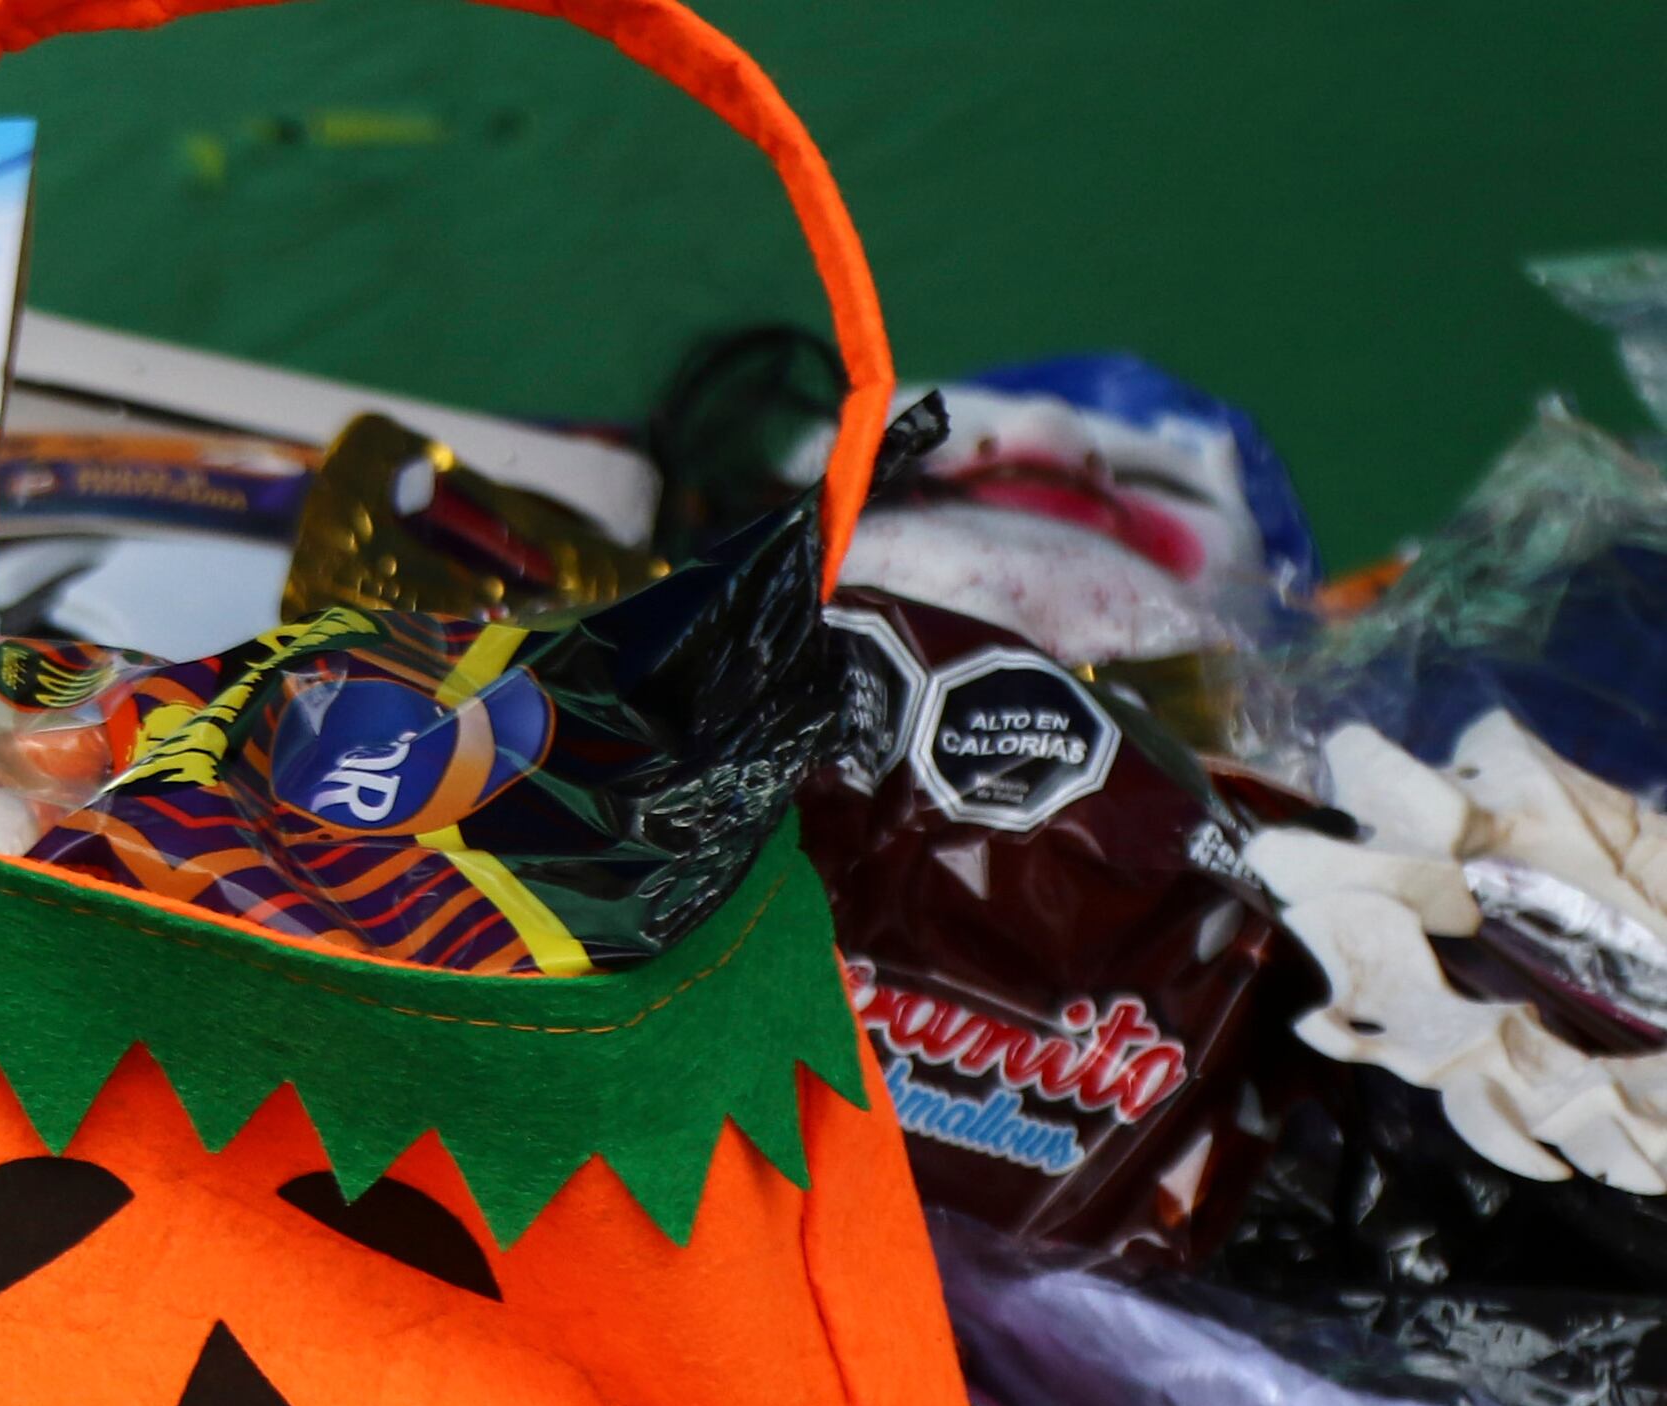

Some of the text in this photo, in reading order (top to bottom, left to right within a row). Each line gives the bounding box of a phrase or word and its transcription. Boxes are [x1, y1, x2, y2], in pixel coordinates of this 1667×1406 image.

[970, 712, 1070, 732] ALTO EN
[941, 731, 1087, 765] CALORÍAS
